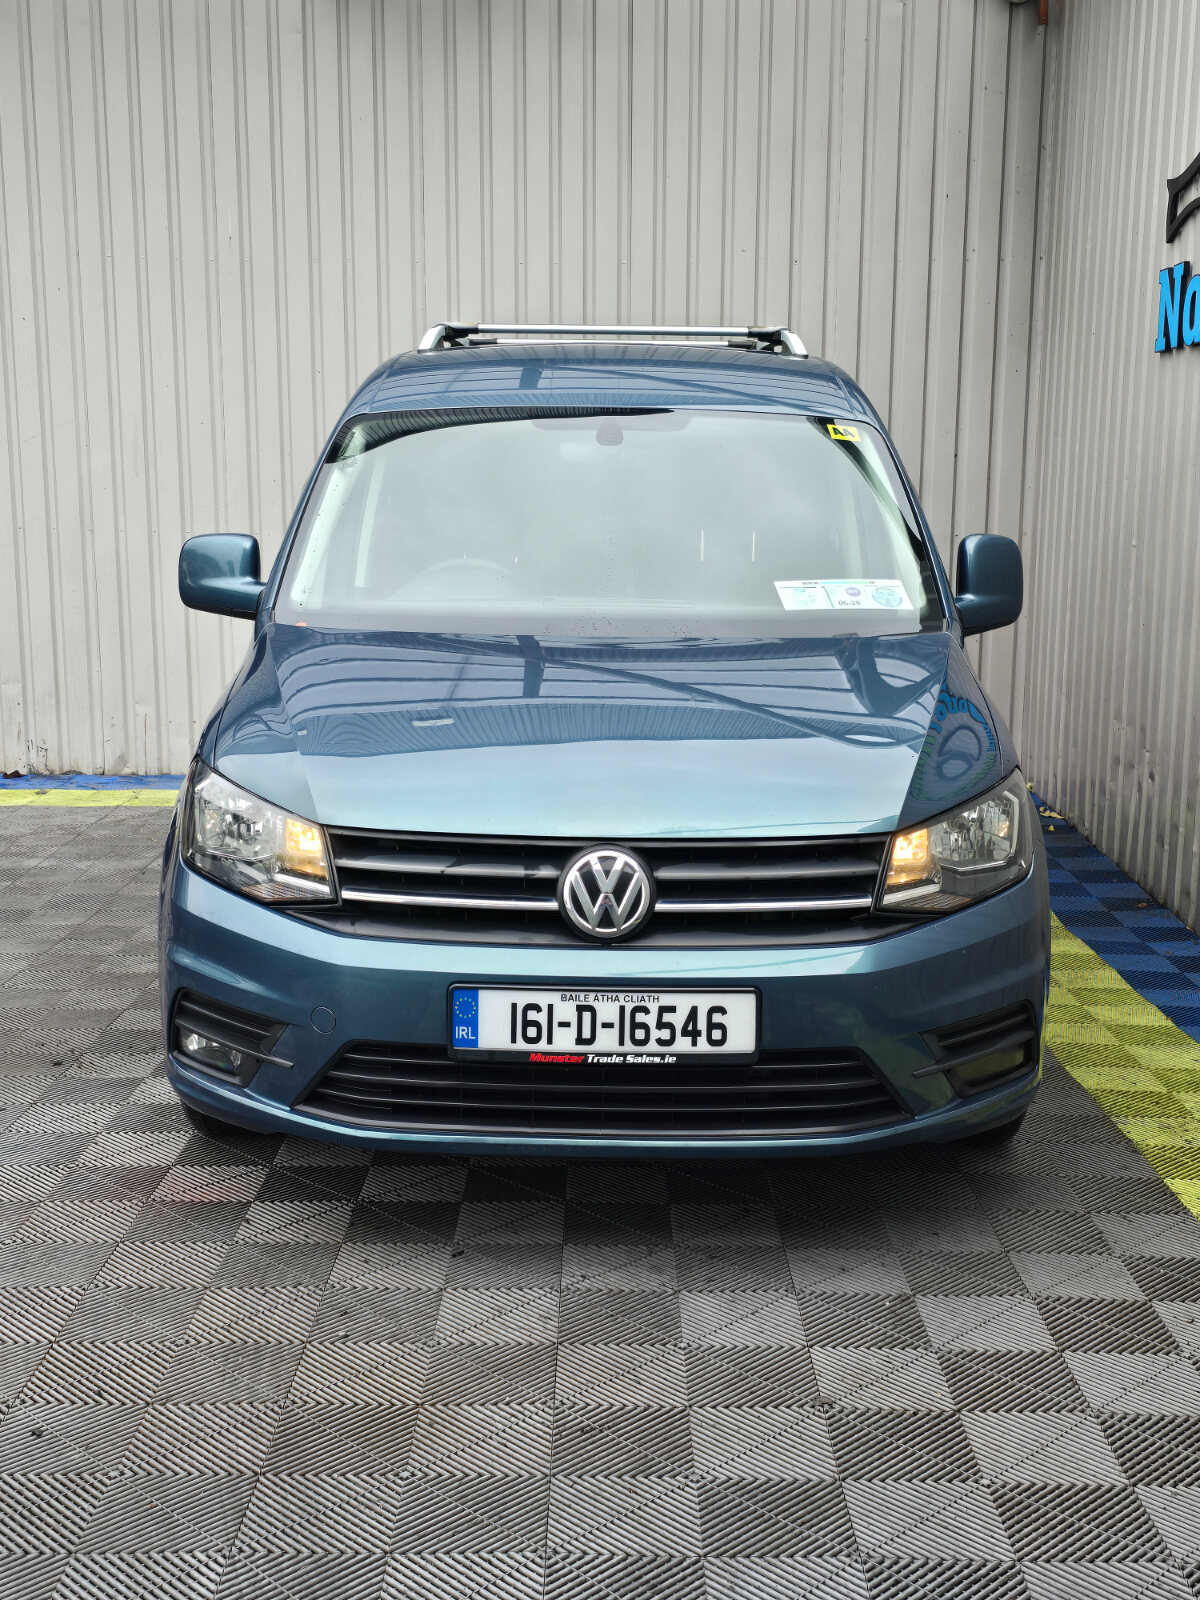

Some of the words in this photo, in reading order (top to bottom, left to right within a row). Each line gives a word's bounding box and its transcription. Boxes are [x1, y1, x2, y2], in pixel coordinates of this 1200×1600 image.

[831, 426, 856, 438] AA
[564, 849, 651, 938] VW
[560, 993, 590, 1002] BAILE
[593, 992, 620, 1003] ÁTHA
[623, 994, 660, 1004] CLIATH
[455, 1026, 475, 1039] IRL
[510, 1002, 728, 1047] 161-D-16546
[529, 1053, 585, 1063] Munster
[587, 1054, 624, 1063] Trade
[626, 1055, 677, 1063] Sales.ie
